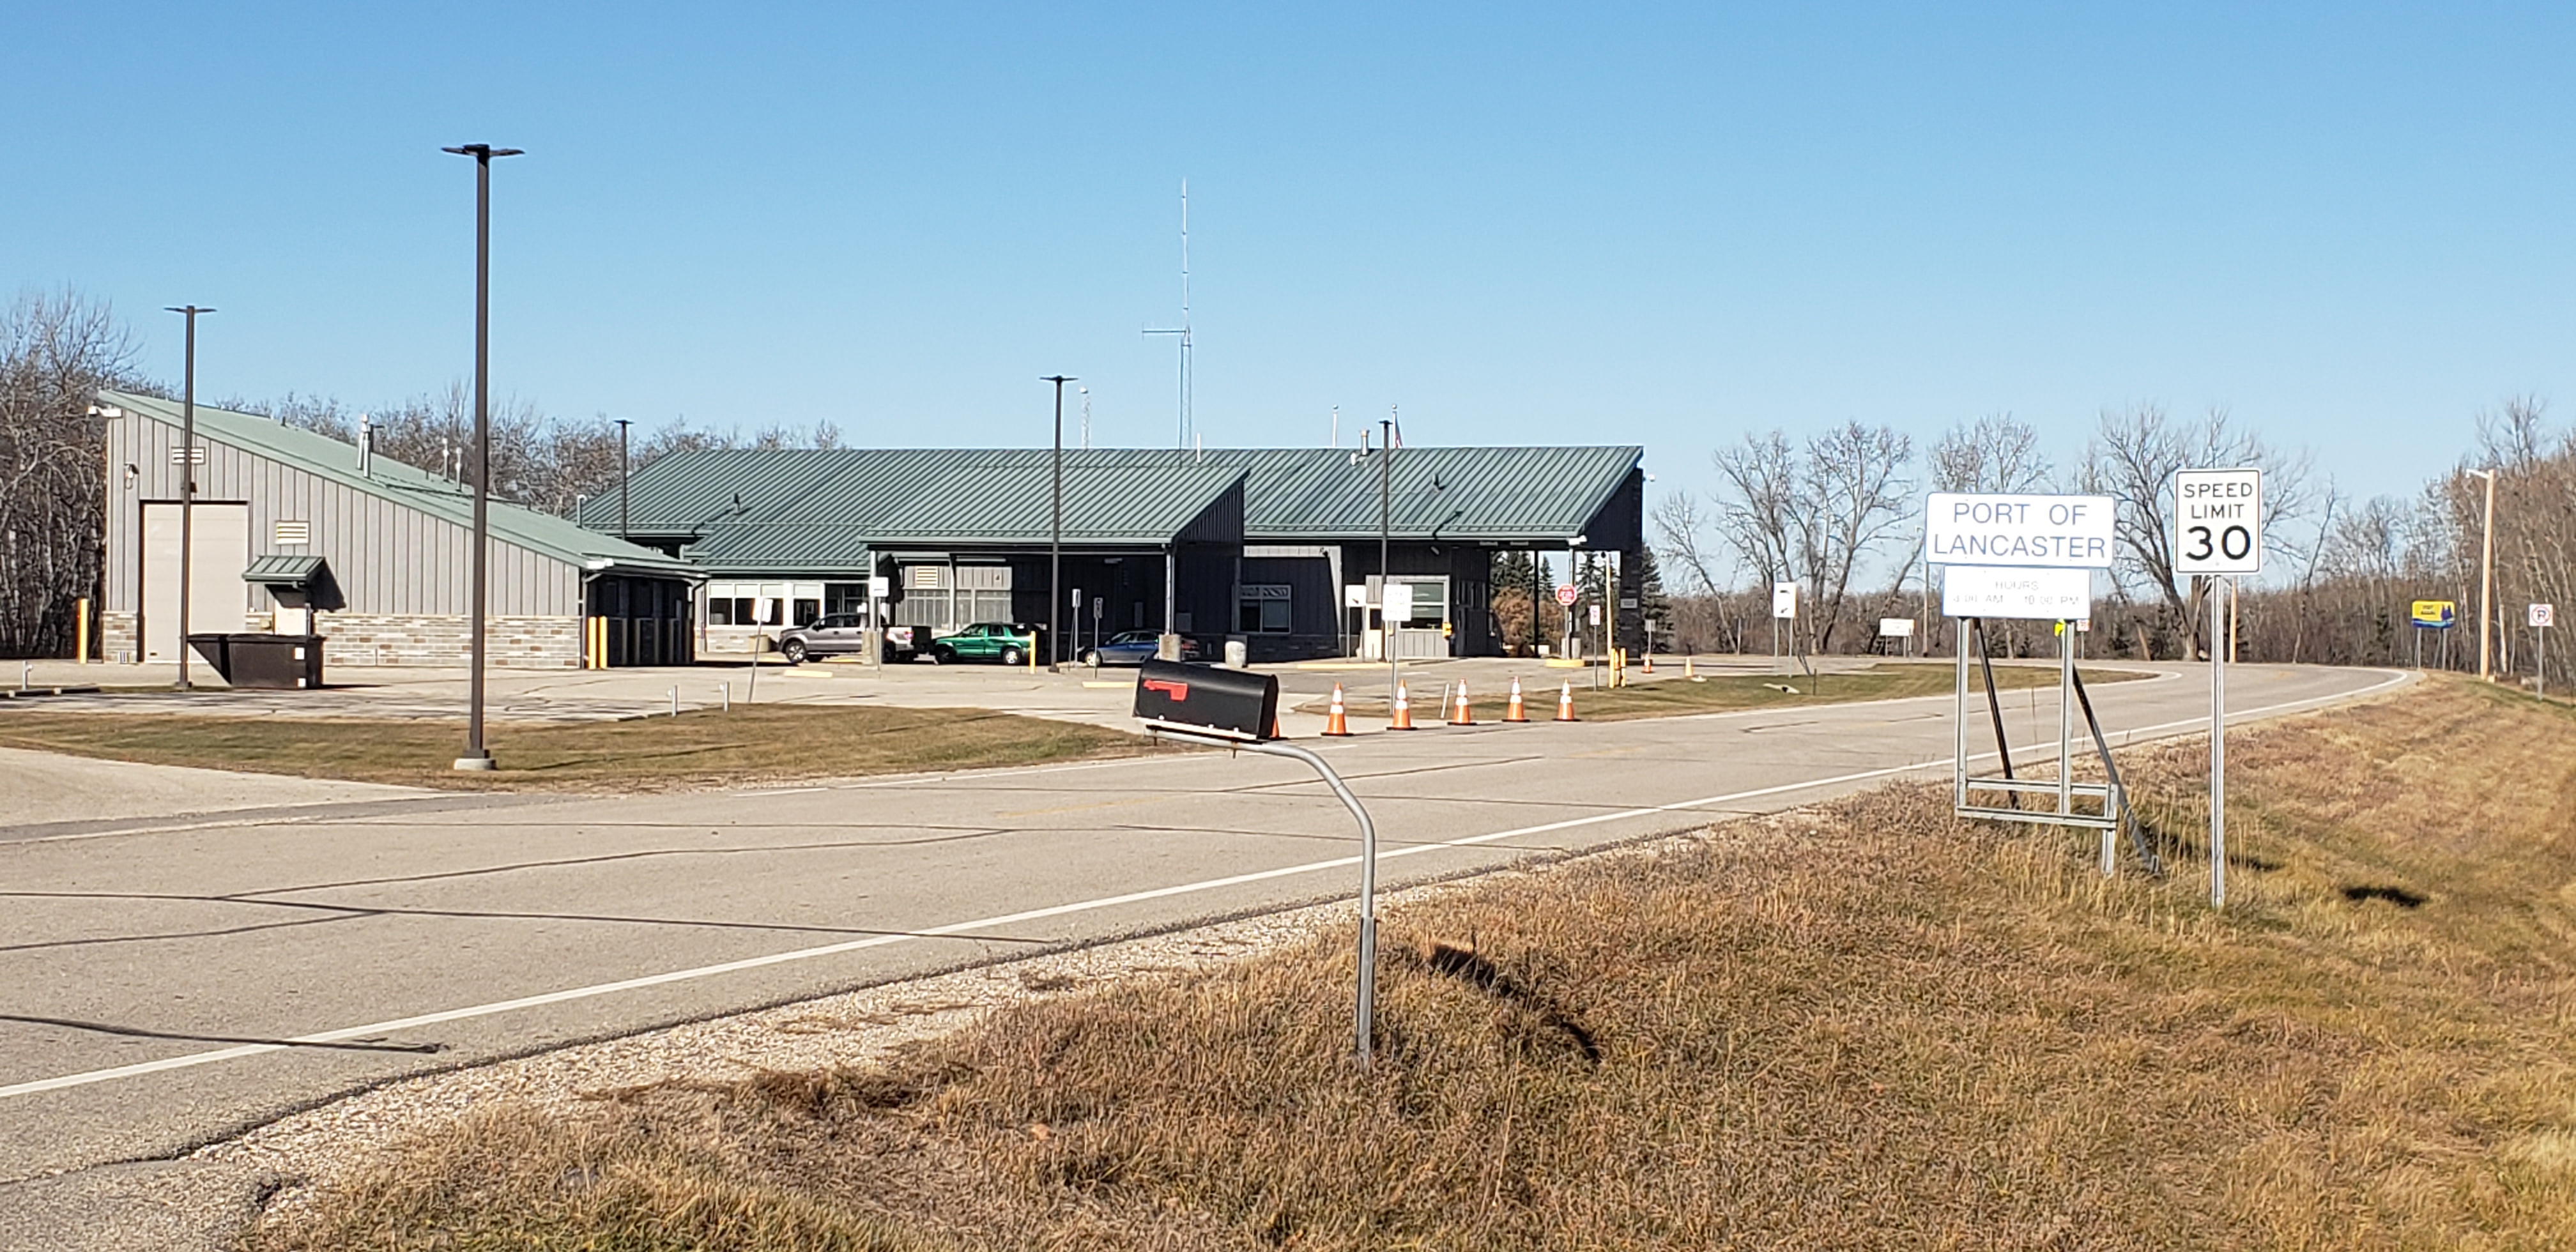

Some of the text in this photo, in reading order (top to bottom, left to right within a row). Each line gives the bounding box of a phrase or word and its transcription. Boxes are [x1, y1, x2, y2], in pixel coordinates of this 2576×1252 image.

[2183, 482, 2253, 498] SPEED
[1954, 502, 2088, 526] PORT OF
[2191, 503, 2244, 519] LIMIT
[1934, 533, 2106, 558] LANCASTER
[2185, 524, 2251, 561] 30
[1995, 580, 2039, 591] HOURS
[1985, 594, 2004, 604] AM
[2025, 595, 2053, 605] 1000
[2060, 595, 2080, 605] PM
